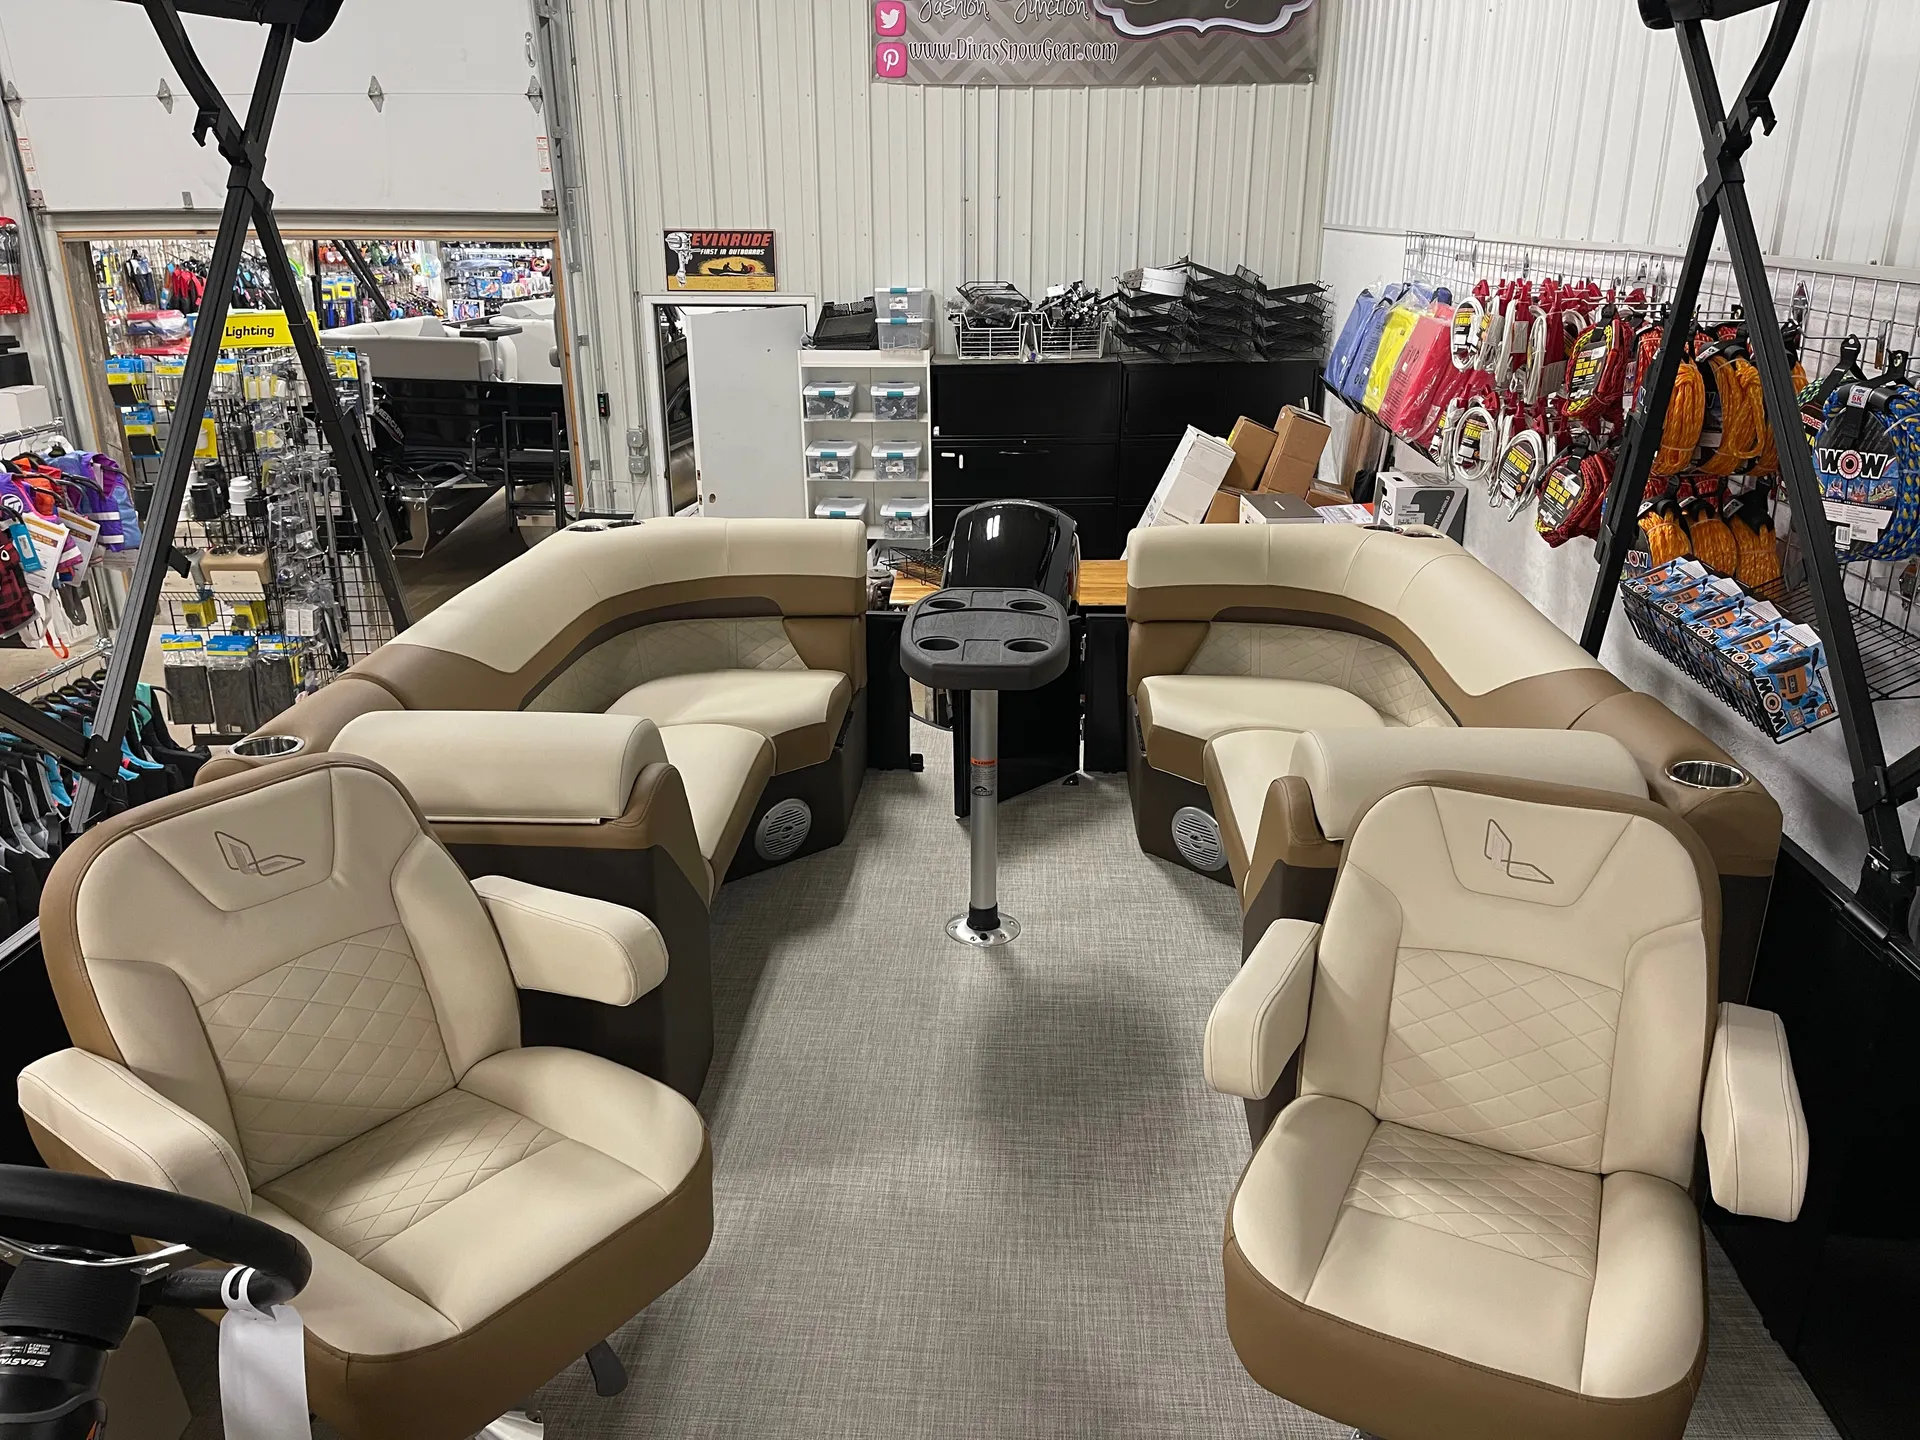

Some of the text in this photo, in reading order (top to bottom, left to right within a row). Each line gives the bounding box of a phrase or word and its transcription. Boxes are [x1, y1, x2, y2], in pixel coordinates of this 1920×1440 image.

[908, 37, 1118, 65] www.DivasSnowGear.com
[691, 233, 772, 246] EVINRUDE
[225, 326, 275, 339] Lighting
[1819, 447, 1888, 479] WOW
[1625, 549, 1649, 568] OW
[1624, 580, 1654, 600] WOW
[1653, 598, 1685, 618] WOW
[1684, 622, 1721, 645] WOW
[1720, 646, 1758, 671] WOW
[1754, 676, 1788, 732] WOW
